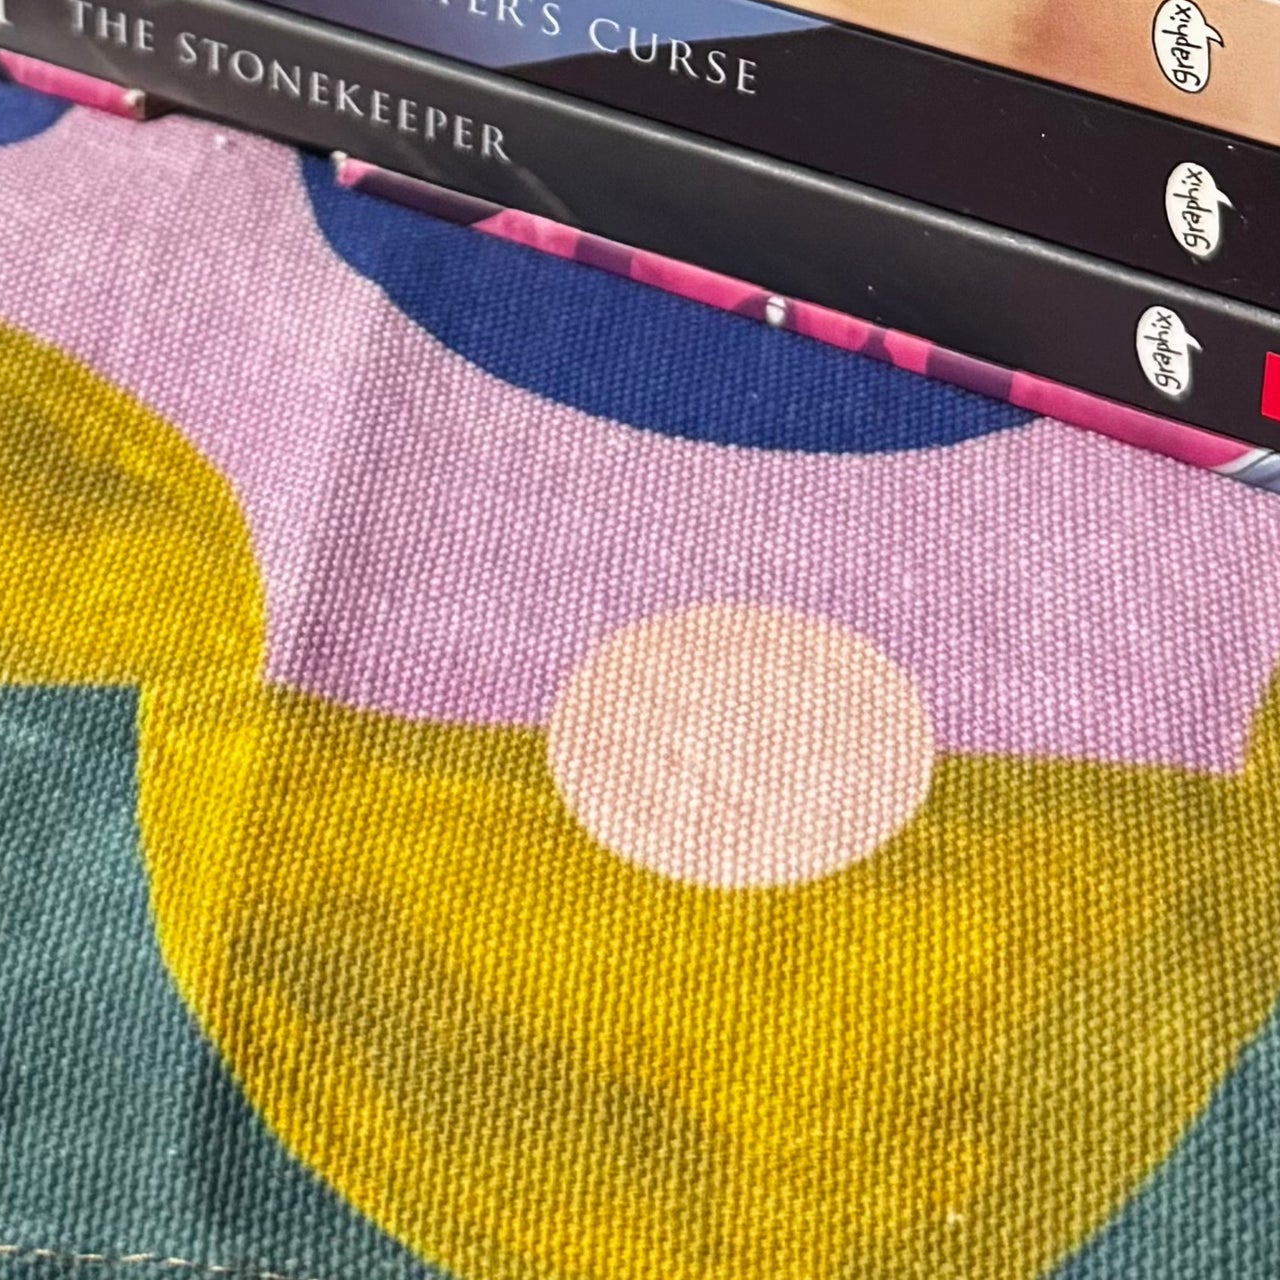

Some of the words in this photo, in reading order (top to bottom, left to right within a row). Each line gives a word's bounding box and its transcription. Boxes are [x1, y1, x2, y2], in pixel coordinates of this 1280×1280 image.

[587, 16, 760, 96] CURSE
[1161, 2, 1202, 88] graphix
[178, 32, 512, 164] STONEKEEPER
[1171, 166, 1212, 252] graphix
[1144, 311, 1182, 391] graphix
